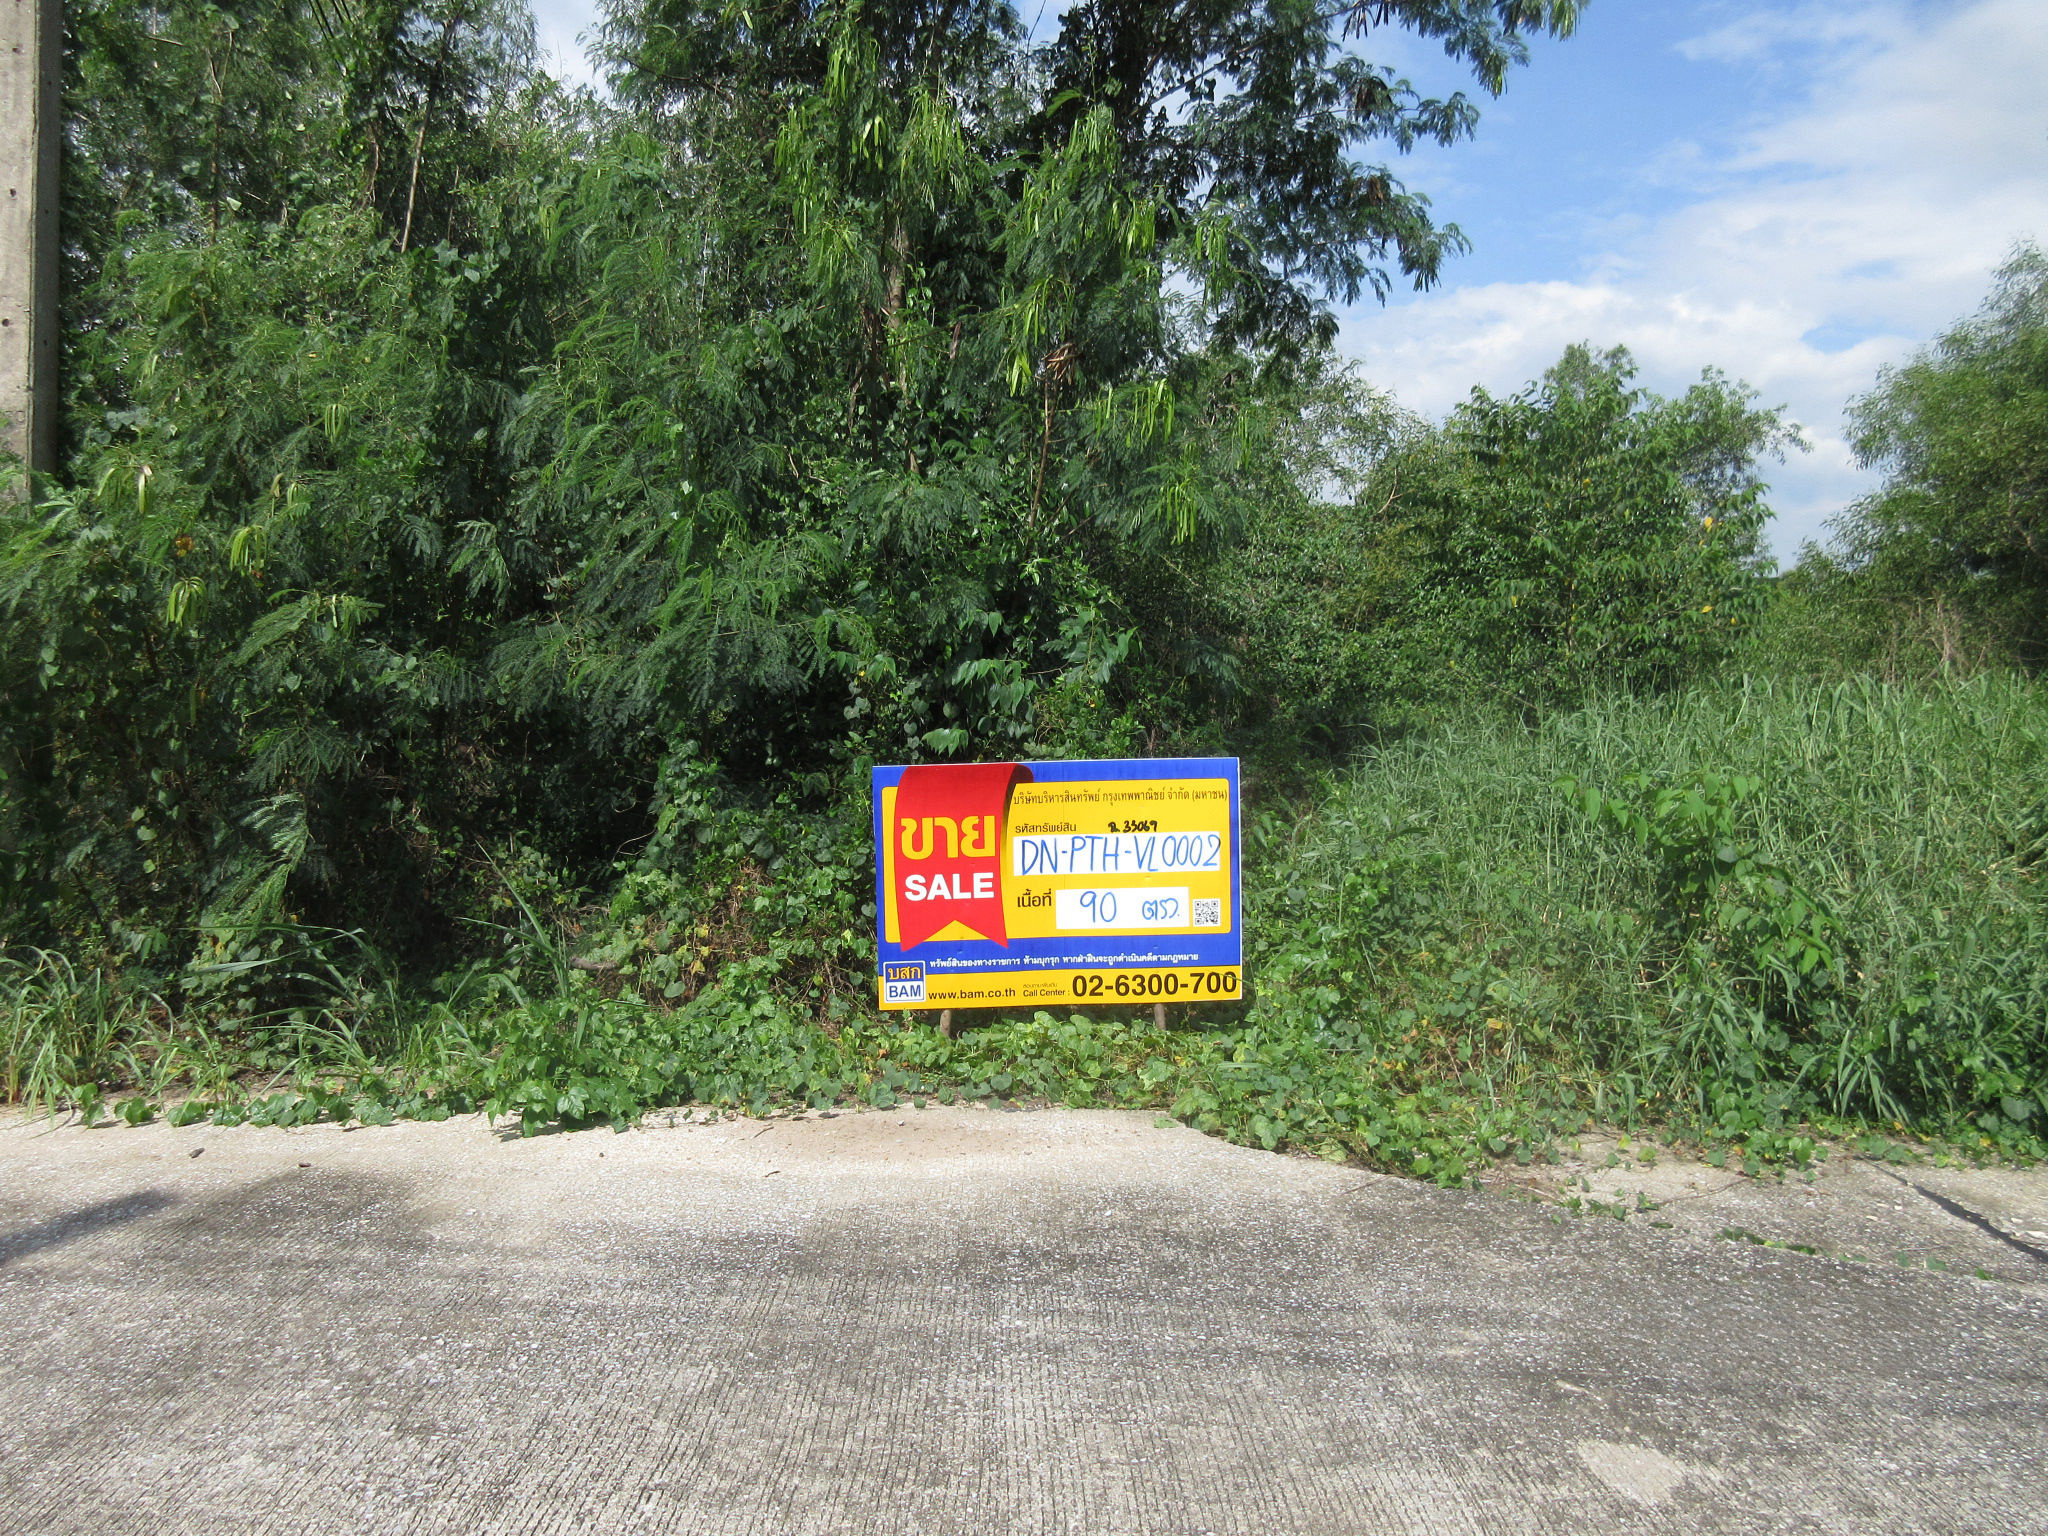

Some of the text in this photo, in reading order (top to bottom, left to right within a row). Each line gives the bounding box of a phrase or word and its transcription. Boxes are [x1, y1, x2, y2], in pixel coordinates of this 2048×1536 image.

[1013, 786, 1228, 806] บริษัทบริหารสินทรัพย์ กรุงเทพพาณิชย์ จำกัด (มหาชน)
[901, 815, 996, 860] ขาย
[1015, 822, 1077, 834] รหัสทรัพย์สิน
[1021, 834, 1221, 876] DN-PTH-VL0002
[905, 872, 995, 901] SALE
[1017, 888, 1052, 908] เนื้อที่
[1079, 890, 1117, 923] 90
[1023, 955, 1060, 967] ห้ามบุกรุก
[888, 965, 921, 980] บสก
[888, 984, 921, 998] BAM
[928, 987, 1016, 1000] www.bam.co.th
[1023, 989, 1038, 997] Call
[1039, 988, 1066, 997] Center
[1072, 971, 1237, 998] 02-6300-700
